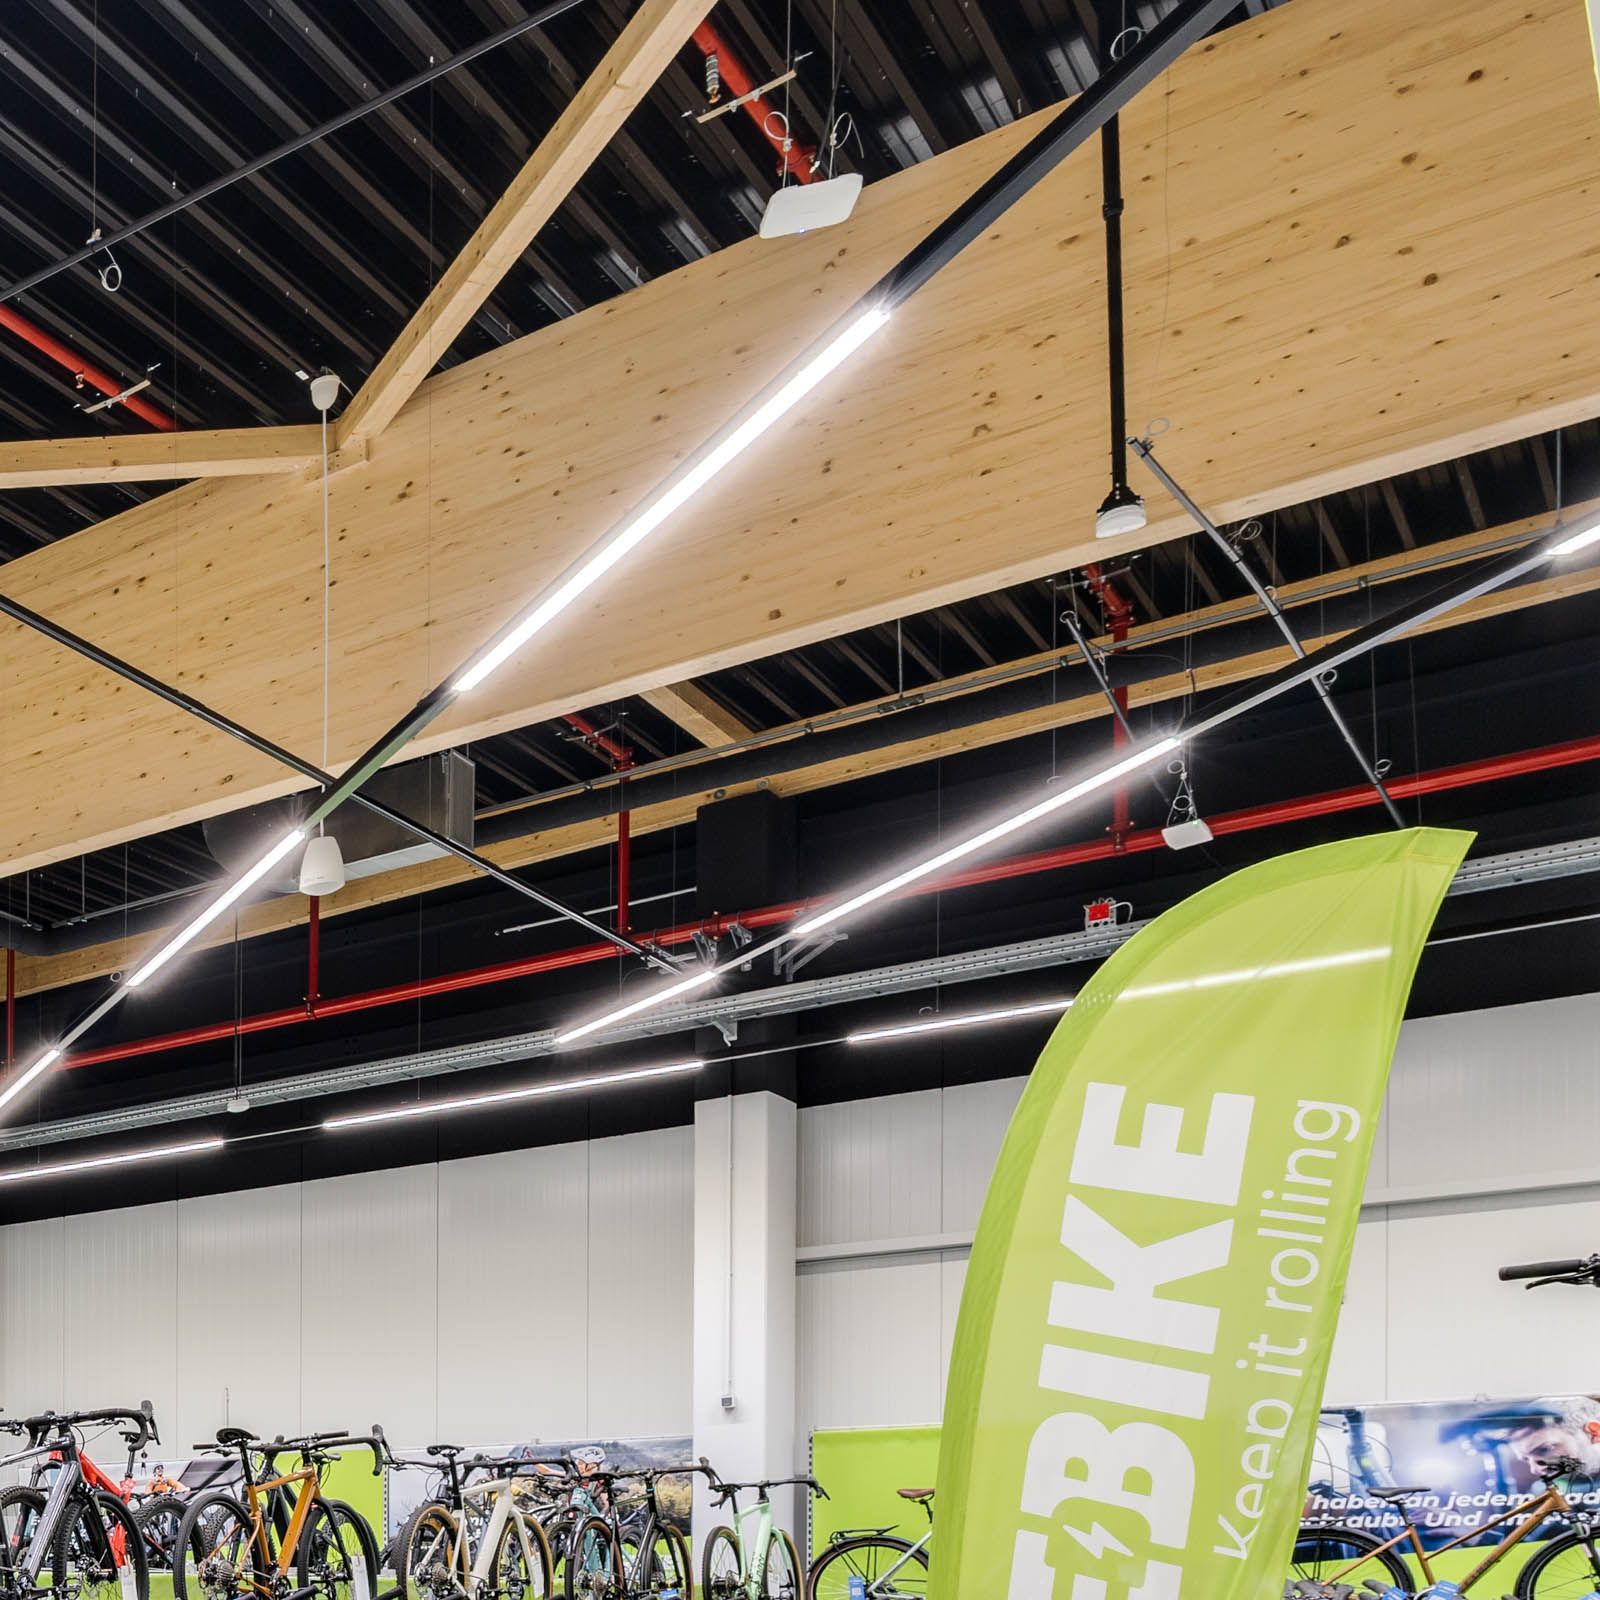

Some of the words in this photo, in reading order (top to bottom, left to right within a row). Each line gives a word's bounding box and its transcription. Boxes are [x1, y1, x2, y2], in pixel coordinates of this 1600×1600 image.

[1258, 1098, 1361, 1314] rolling
[1234, 1321, 1307, 1381] it
[1212, 1395, 1288, 1561] Keep
[1311, 1495, 1397, 1511] haben
[1425, 1512, 1484, 1528] Und
